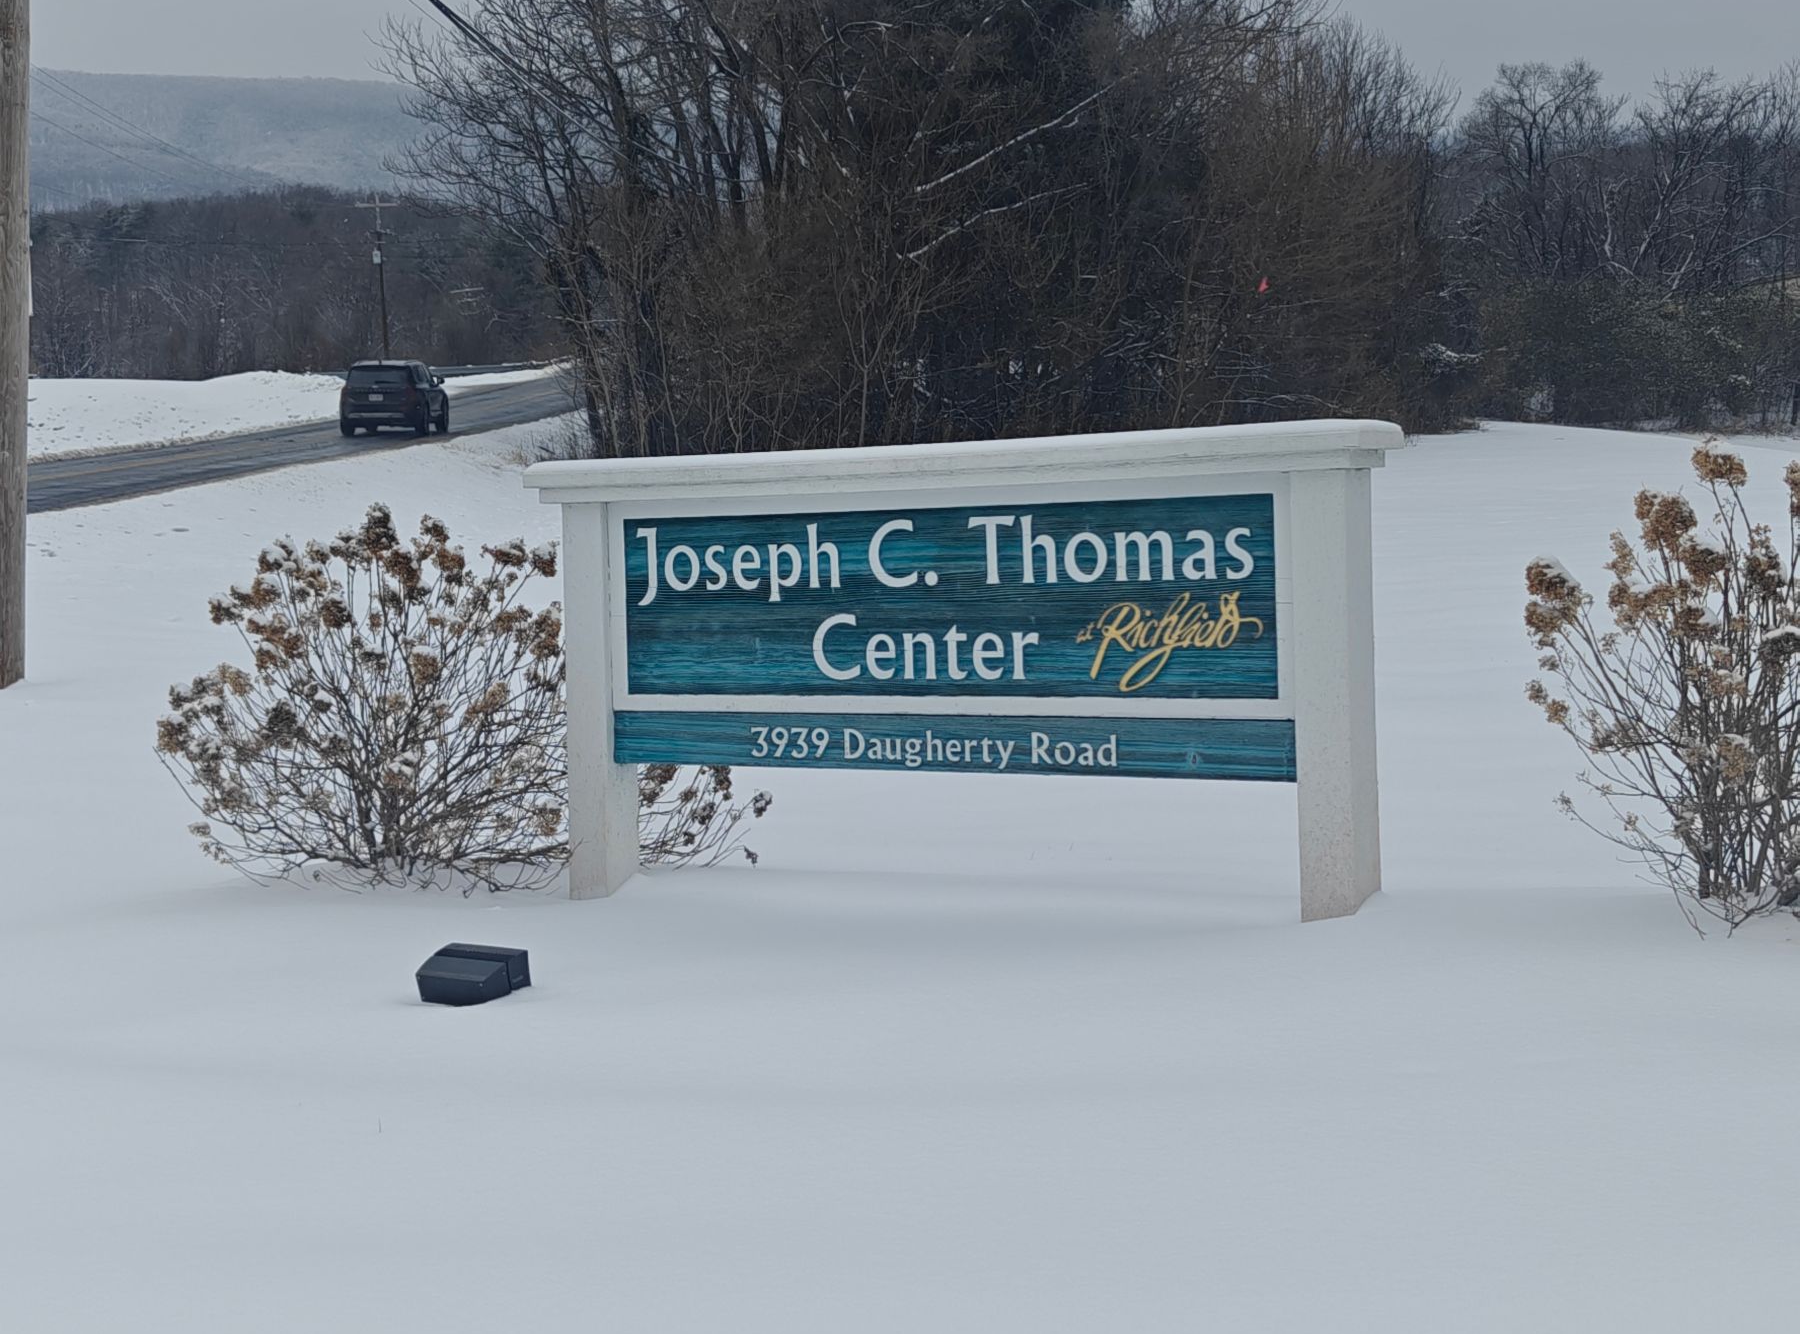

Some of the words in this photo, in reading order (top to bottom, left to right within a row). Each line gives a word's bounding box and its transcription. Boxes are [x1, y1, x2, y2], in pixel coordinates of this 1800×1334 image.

[635, 522, 842, 605] Joseph
[867, 518, 940, 588] C.
[966, 514, 1256, 585] Thomas
[812, 613, 1039, 681] Center
[1087, 591, 1264, 692] Richfield
[750, 726, 830, 759] 3939
[842, 728, 1015, 769] Daugherty
[1030, 731, 1118, 768] Road
